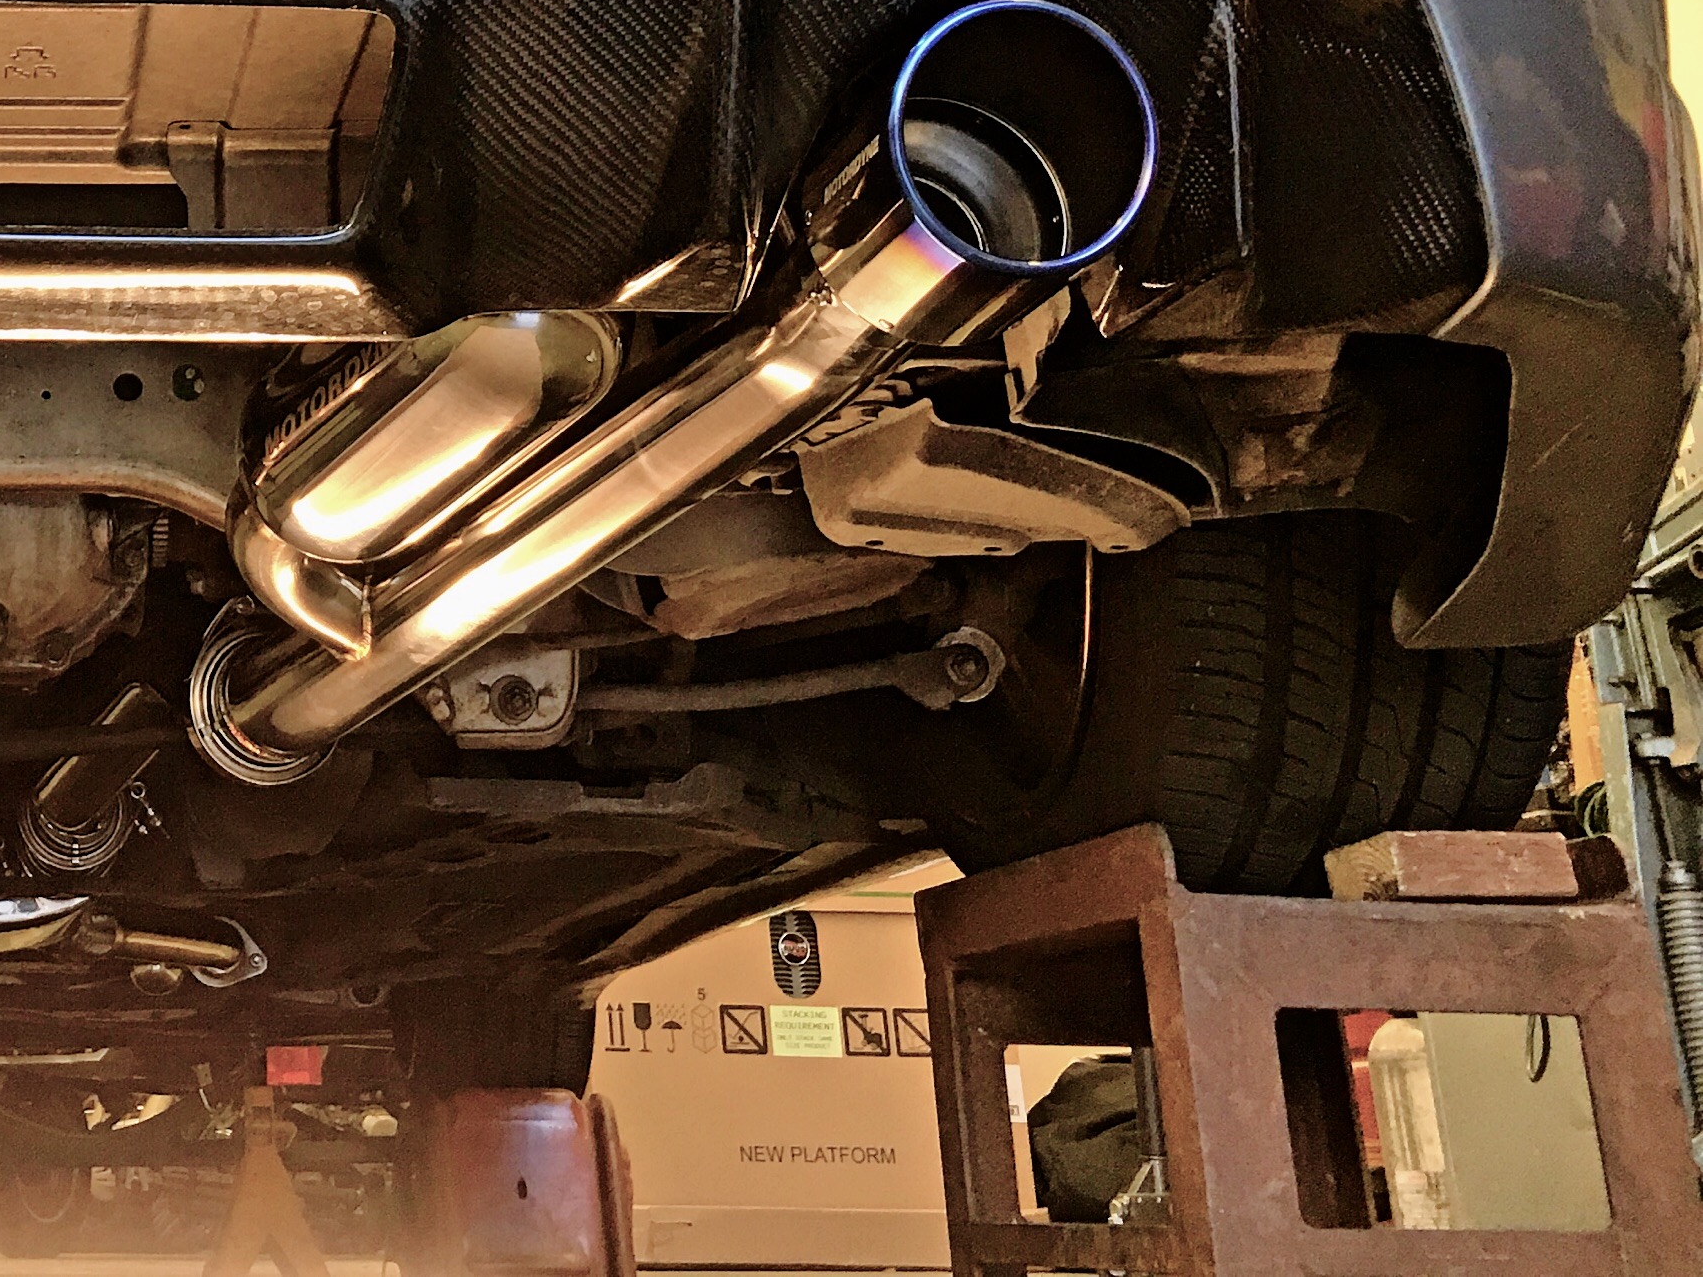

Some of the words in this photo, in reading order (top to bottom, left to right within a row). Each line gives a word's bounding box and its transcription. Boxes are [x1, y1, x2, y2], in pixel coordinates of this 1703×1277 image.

[697, 987, 706, 1001] 5
[739, 1146, 784, 1163] NEW
[791, 1146, 896, 1164] PLATFORM
